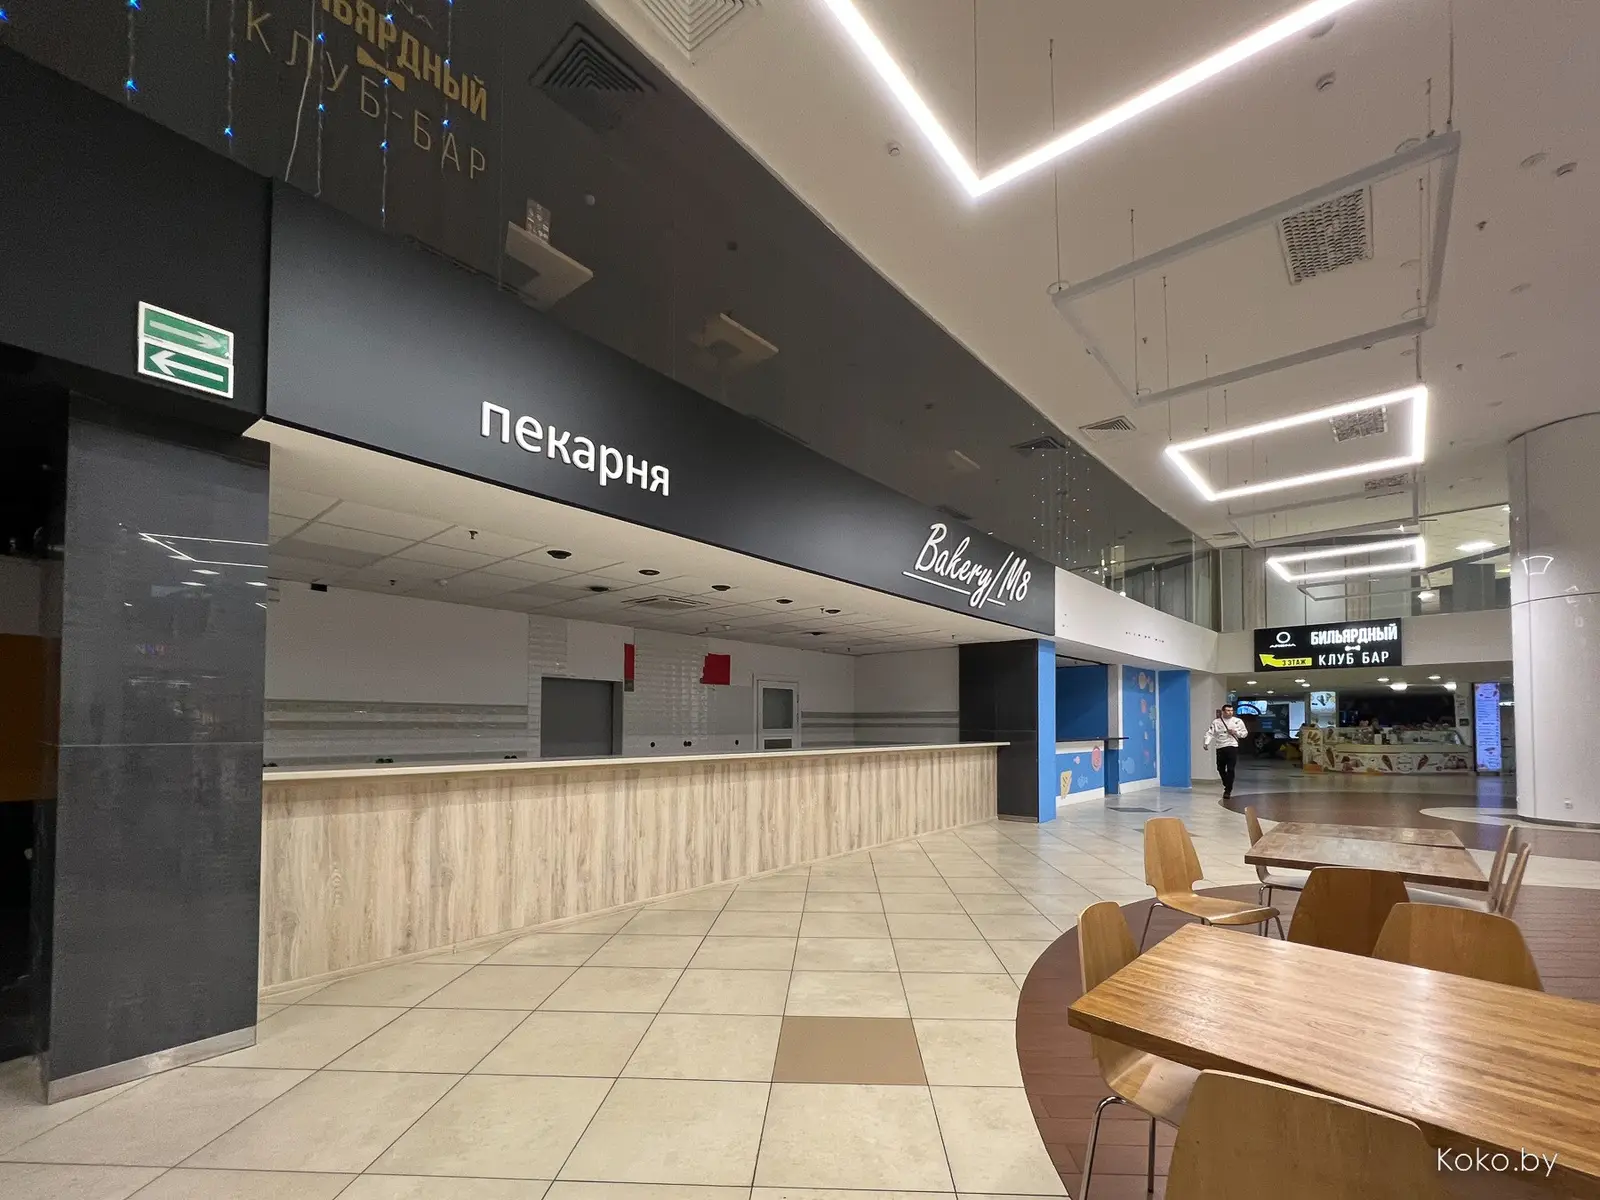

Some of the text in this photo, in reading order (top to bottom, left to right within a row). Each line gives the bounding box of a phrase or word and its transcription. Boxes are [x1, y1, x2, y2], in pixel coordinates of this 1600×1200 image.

[480, 400, 670, 497] пекарня
[1310, 623, 1398, 646] БИЛЬЯРДНЫЙ
[1318, 651, 1390, 666] КЛУБ БАР
